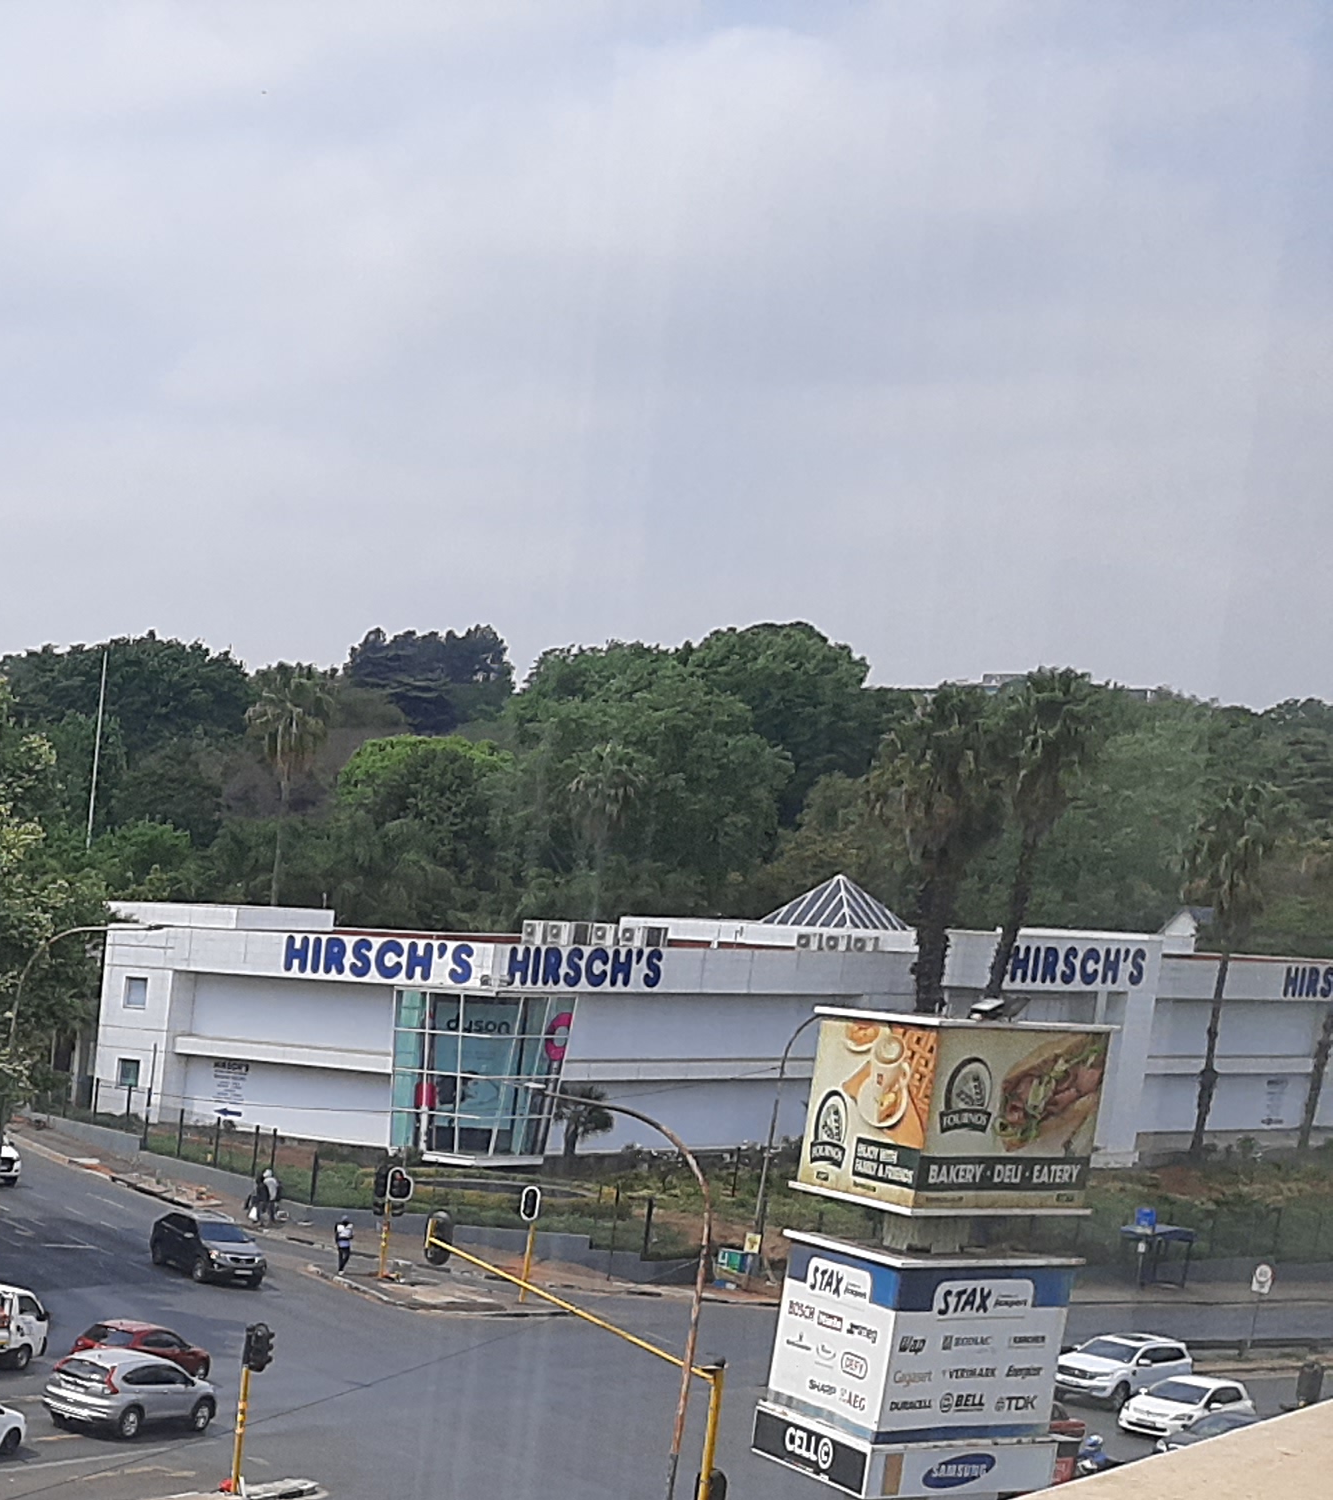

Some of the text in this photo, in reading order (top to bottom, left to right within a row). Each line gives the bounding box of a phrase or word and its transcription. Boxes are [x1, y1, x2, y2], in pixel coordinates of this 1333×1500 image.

[283, 934, 474, 984] HIRSCH'S
[506, 945, 663, 988] HIRSCH'S
[1009, 944, 1147, 987] HIRSCH'S
[446, 1011, 511, 1034] dyson
[927, 1163, 1082, 1184] BAKERY DELI EATERY
[809, 1265, 844, 1298] STAX
[937, 1286, 992, 1315] STAX
[846, 1391, 866, 1411] AEG
[954, 1394, 985, 1407] BELL
[1006, 1395, 1039, 1411] TDK
[931, 1463, 987, 1478] SAMSUNG
